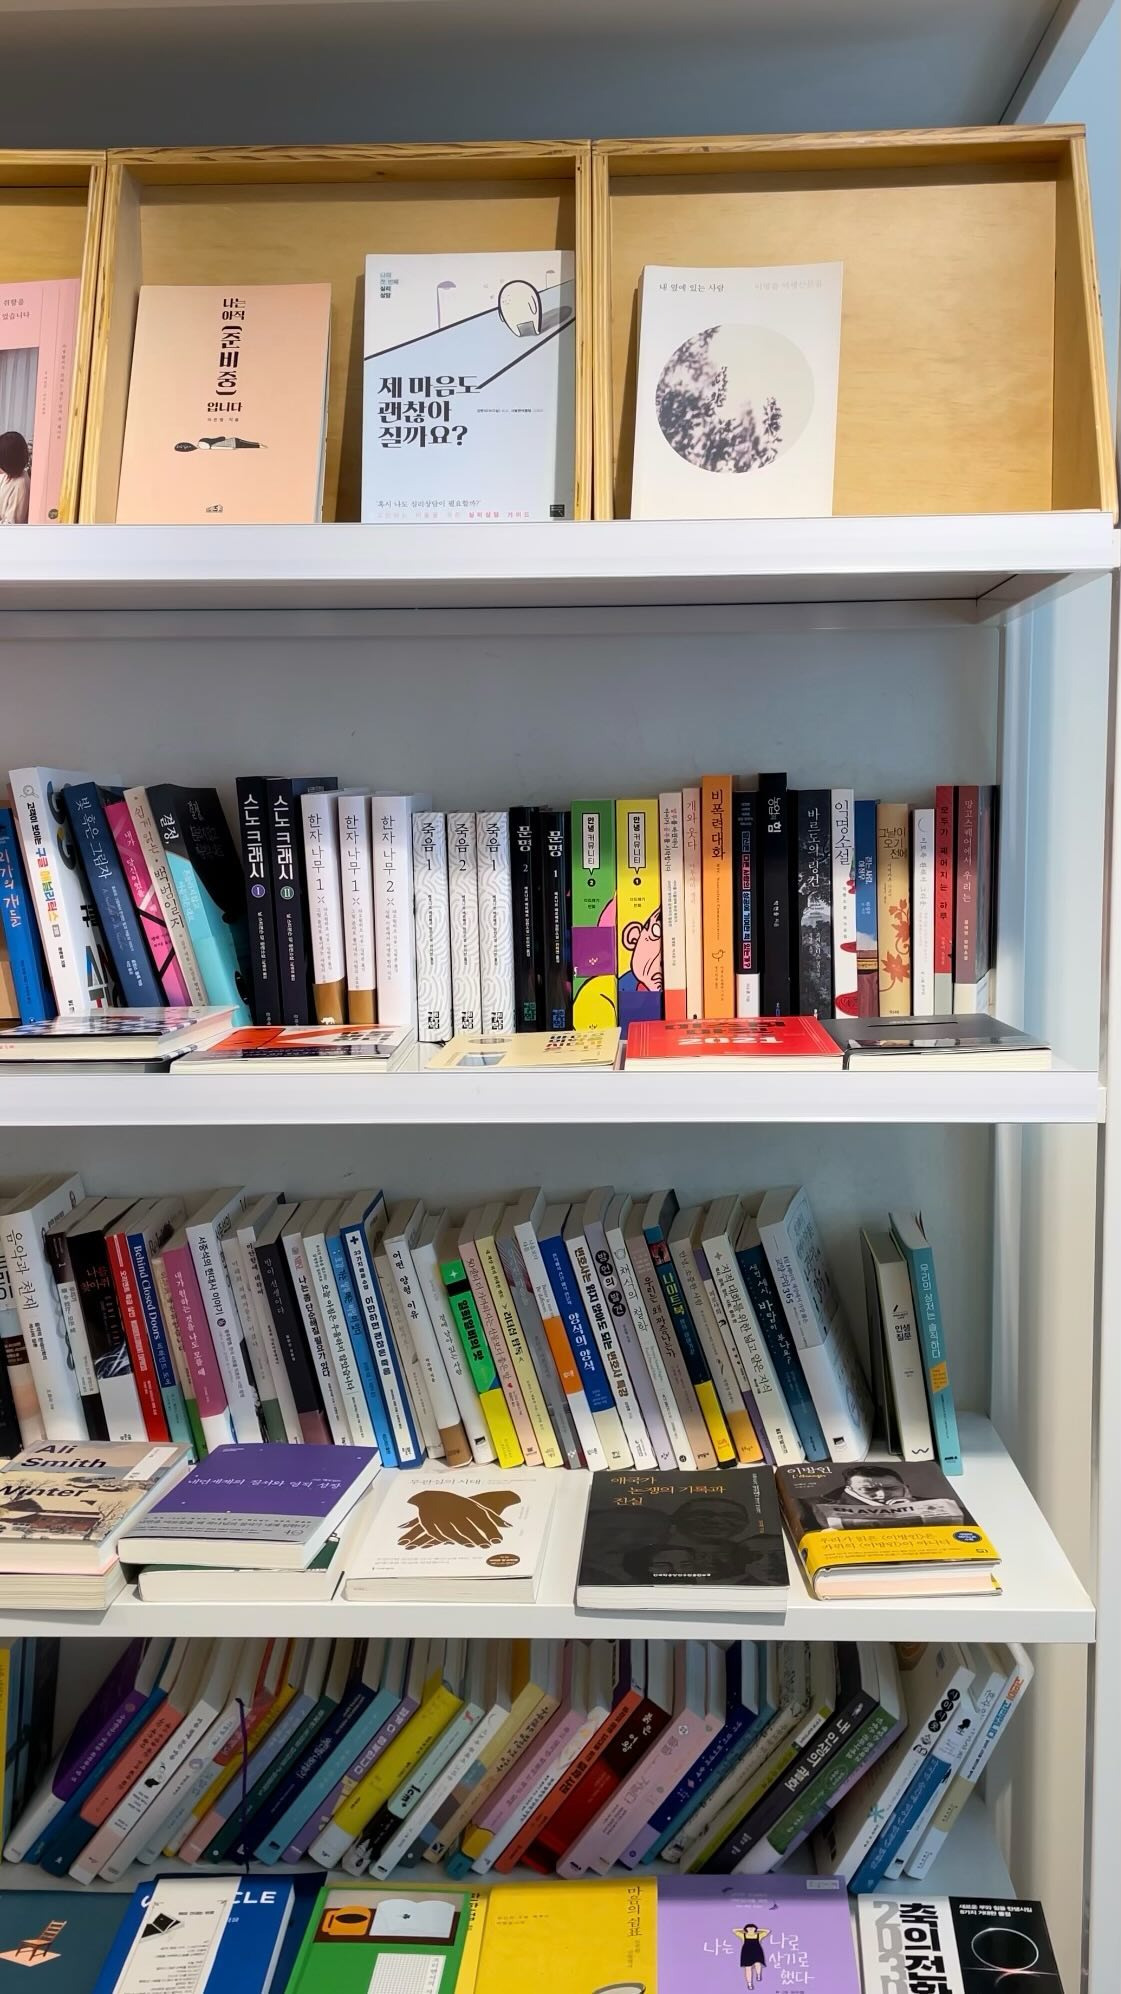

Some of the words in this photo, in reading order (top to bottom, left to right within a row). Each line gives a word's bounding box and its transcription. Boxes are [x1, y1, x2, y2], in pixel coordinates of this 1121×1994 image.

[671, 284, 686, 292] 옆에
[709, 284, 724, 292] 사람
[223, 298, 245, 308] 나는
[222, 310, 244, 320] 아직
[378, 376, 402, 398] 제
[410, 376, 480, 398] 마음도
[207, 402, 242, 412] 입니다
[378, 401, 452, 423] 괜찮아
[379, 426, 467, 448] 질까요?
[26, 802, 36, 827] 고객이
[76, 798, 90, 810] 빛
[243, 794, 260, 826] 스노
[273, 796, 290, 827] 스노
[686, 800, 697, 824] 개와
[80, 813, 96, 838] 혹은
[308, 814, 322, 842] 한자
[345, 816, 359, 844] 한자
[381, 816, 395, 844] 한자
[588, 817, 595, 832] 안녕
[633, 816, 640, 831] 안녕
[711, 789, 725, 861] 비폭력대화
[768, 821, 780, 832] 힘
[880, 827, 906, 838] 그날이
[940, 806, 948, 837] 모두가
[31, 827, 42, 844] 보이는
[422, 822, 436, 852] 죽음
[455, 823, 469, 852] 죽음
[486, 822, 501, 852] 죽음
[517, 826, 533, 852] 문명
[548, 831, 563, 857] 문명
[686, 827, 697, 850] 웃다
[808, 808, 821, 860] 바르도의
[835, 800, 850, 866] 익명소설
[884, 838, 902, 849] 오기
[35, 848, 49, 868] 구글
[247, 830, 265, 879] 크래시
[276, 832, 294, 881] 크래시
[633, 834, 641, 864] 커뮤니티
[890, 849, 907, 860] 전에
[91, 842, 113, 880] 그림자
[311, 847, 325, 874] 나무
[348, 850, 360, 875] 나무
[383, 848, 396, 875] 나무
[426, 860, 432, 871] 1
[459, 860, 466, 871] 2
[491, 860, 497, 871] 1
[523, 864, 529, 872] 2
[742, 854, 750, 868] 다른
[864, 856, 871, 868] 걷는
[316, 878, 323, 891] 1
[554, 870, 558, 878] 1
[808, 861, 820, 887] 링컨
[39, 870, 61, 922] 애널리틱스
[352, 880, 359, 892] 1
[387, 881, 394, 892] 2
[963, 870, 972, 903] 우리는
[155, 866, 186, 929] 백범일지
[939, 901, 948, 920] 하루
[744, 942, 752, 968] 있는가?
[678, 1037, 784, 1045] 2021
[5, 1230, 31, 1275] 음악과
[196, 1235, 211, 1267] 서중석의
[338, 1268, 348, 1281] 가는
[574, 1246, 592, 1283] 변호사는
[718, 1262, 734, 1283] 지적
[118, 1270, 130, 1292] 오리엔트
[204, 1267, 217, 1291] 현대사
[297, 1274, 308, 1292] 나는
[392, 1249, 405, 1270] 어떤
[399, 1274, 412, 1295] 양형
[406, 1300, 419, 1320] 이유
[684, 1268, 698, 1290] 소중한
[691, 1291, 703, 1306] 사람
[16, 1278, 39, 1310] 천재
[320, 1283, 331, 1299] 오늘
[585, 1283, 598, 1303] 읽지
[725, 1283, 744, 1313] 대화를
[782, 1287, 794, 1304] 365
[210, 1292, 223, 1315] 이야기
[324, 1299, 337, 1322] 아침은
[364, 1296, 379, 1330] 이만하면
[134, 1245, 148, 1278] Behind
[141, 1279, 155, 1310] Closed
[148, 1311, 161, 1340] Doors
[156, 1342, 168, 1370] 비하인드
[162, 1370, 171, 1385] 도어
[304, 1303, 320, 1336] 단순해질
[591, 1303, 607, 1331] 않아도
[735, 1312, 751, 1333] 위한
[330, 1322, 345, 1352] 우울하지
[502, 1310, 517, 1336] 리더십
[511, 1337, 523, 1355] 탐독
[895, 1324, 911, 1332] 인생
[896, 1332, 912, 1341] 질문
[313, 1335, 326, 1360] 필요가
[373, 1331, 386, 1357] 괜찮은
[567, 1311, 587, 1347] 양식의
[579, 1348, 596, 1373] 양식
[600, 1331, 613, 1350] 되는
[743, 1333, 758, 1353] 넓고
[472, 1349, 484, 1361] 맛
[606, 1350, 621, 1378] 변호사
[750, 1353, 765, 1373] 얕은
[319, 1361, 331, 1377] 있다
[338, 1353, 355, 1390] 않았습니다
[379, 1358, 390, 1376] 죽음
[615, 1378, 628, 1398] 특강
[757, 1373, 772, 1394] 지식
[35, 1444, 77, 1455] Ali
[21, 1458, 107, 1468] Smith
[786, 1467, 833, 1475] 이방인
[459, 1478, 481, 1486] 시대
[611, 1476, 656, 1485] 애국가
[628, 1485, 674, 1495] 논쟁의
[678, 1485, 727, 1495] 기록과
[0, 1486, 91, 1498] Winter
[613, 1497, 644, 1506] 진실
[833, 1506, 861, 1516] EN
[864, 1506, 915, 1515] AVANT!
[819, 1536, 850, 1546] 우리가
[854, 1535, 877, 1543] 읽은
[525, 1706, 551, 1734] 아무래도
[837, 1719, 851, 1734] 내
[810, 1732, 839, 1768] 인생의
[628, 1886, 642, 1916] 마음의
[900, 1903, 941, 1951] 축의
[703, 1938, 735, 1954] 나는
[769, 1932, 800, 1950] 나로
[768, 1951, 809, 1968] 살기로
[781, 1970, 816, 1985] 했다
